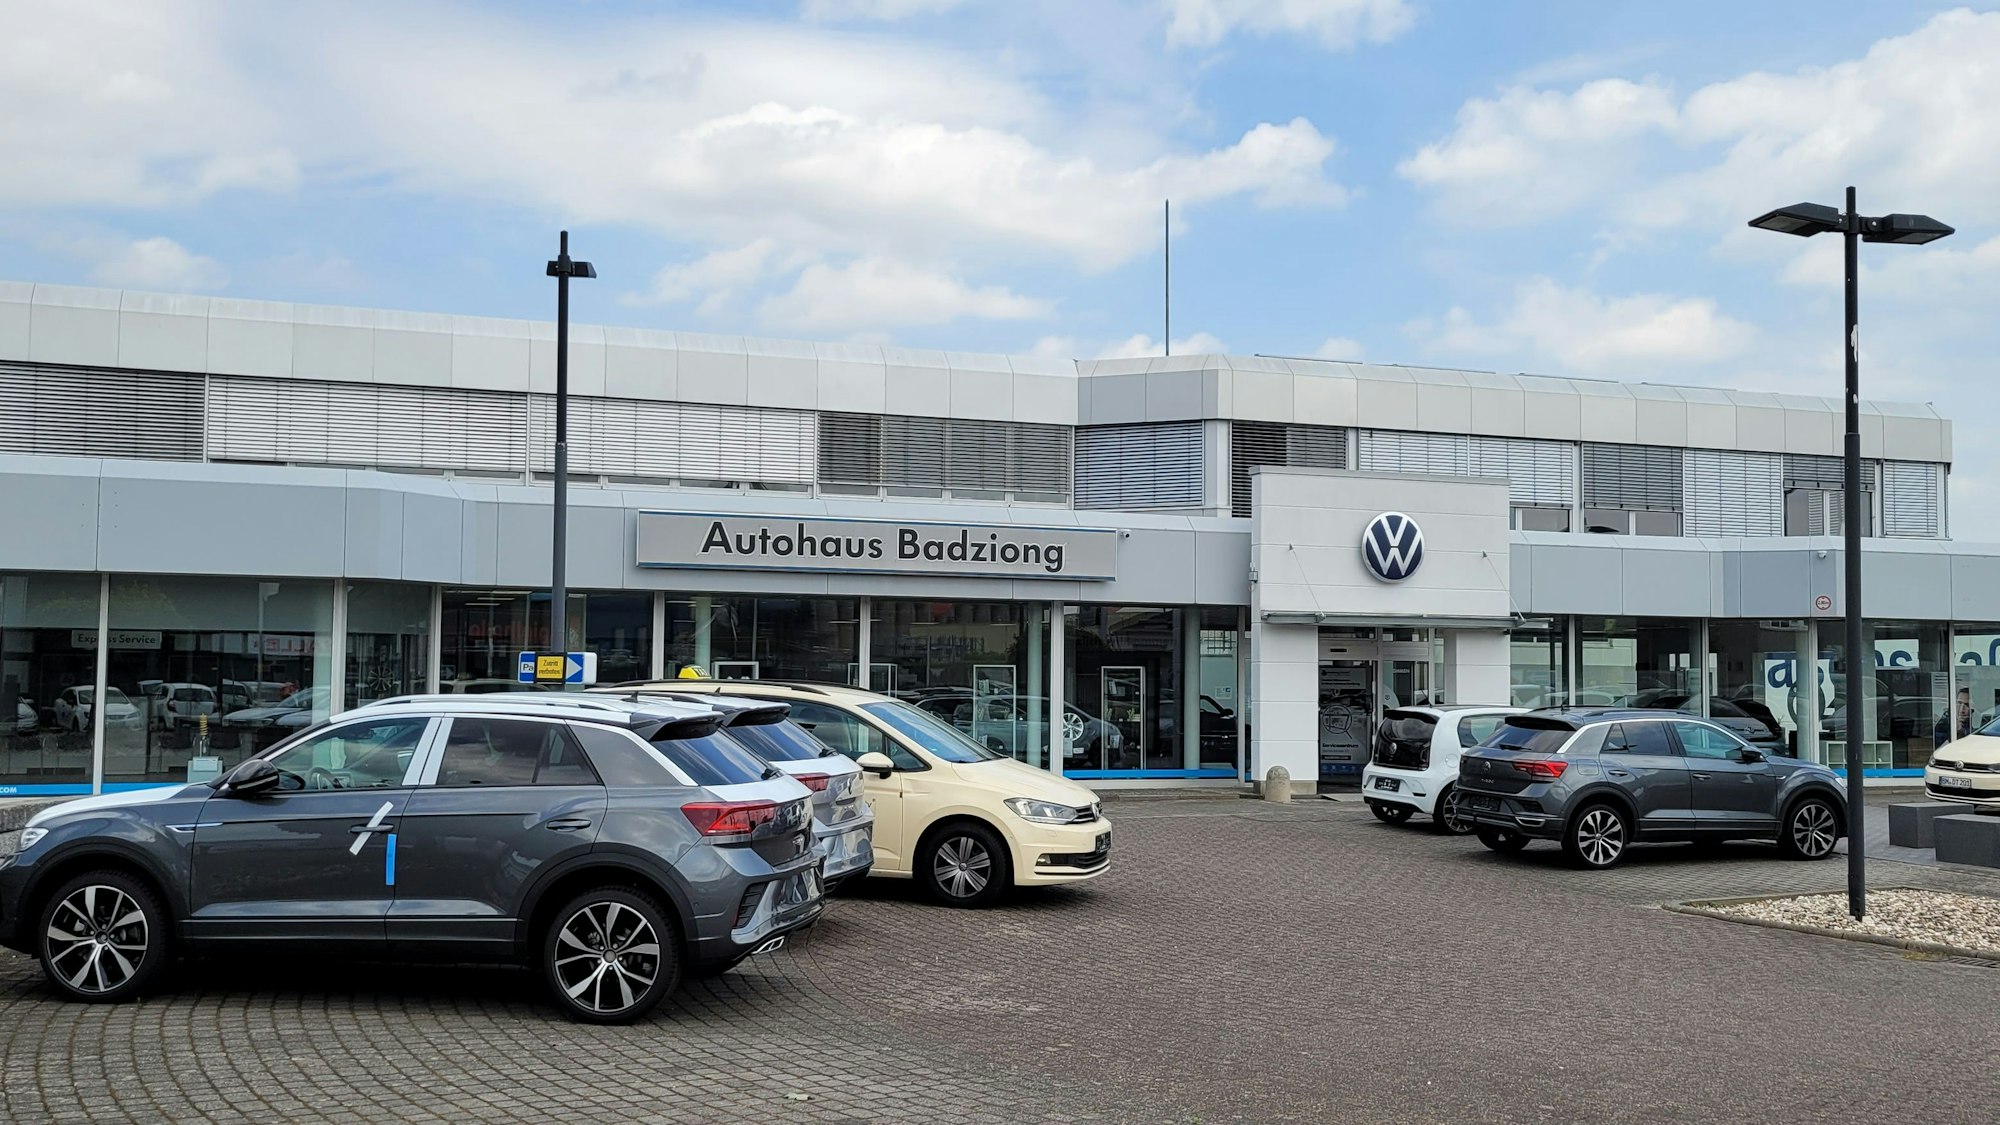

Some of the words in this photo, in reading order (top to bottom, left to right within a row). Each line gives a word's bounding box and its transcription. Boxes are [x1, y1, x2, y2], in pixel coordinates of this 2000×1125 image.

[701, 521, 883, 560] Autohaus
[898, 528, 1064, 573] Badziong
[119, 634, 156, 644] Service
